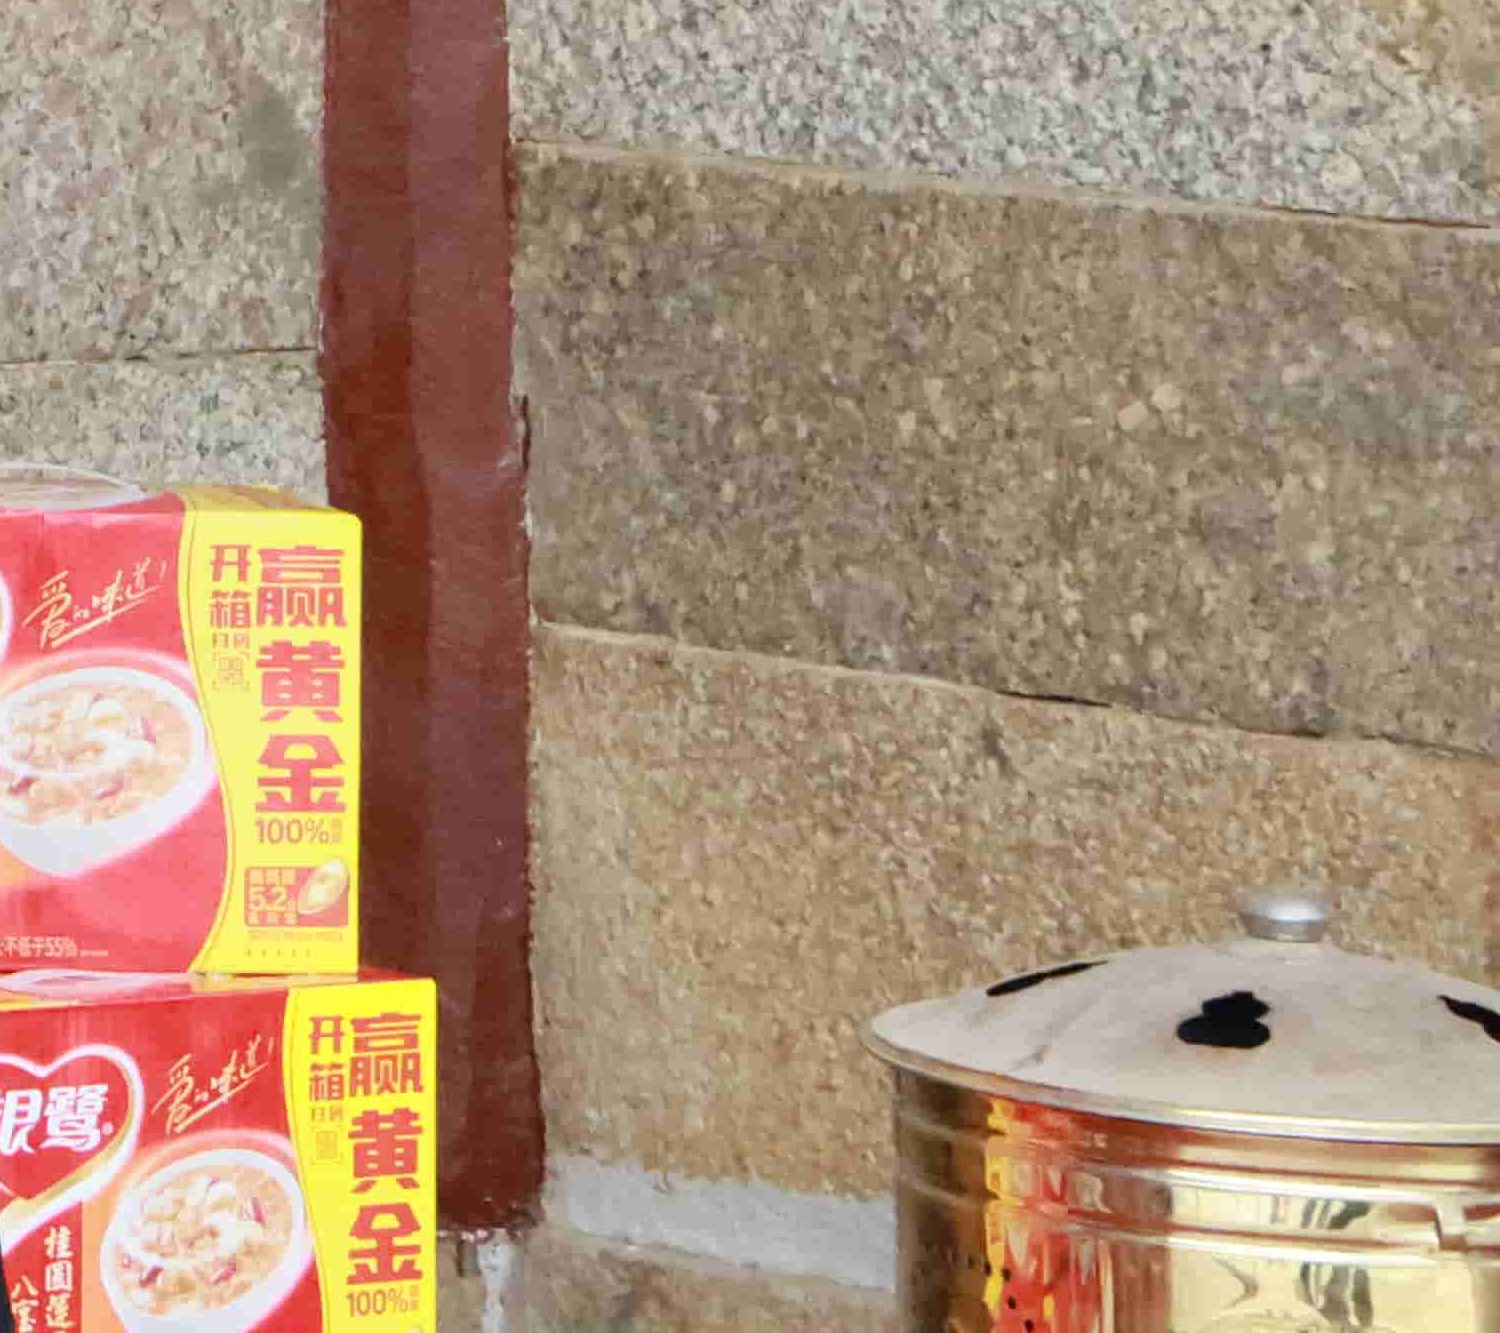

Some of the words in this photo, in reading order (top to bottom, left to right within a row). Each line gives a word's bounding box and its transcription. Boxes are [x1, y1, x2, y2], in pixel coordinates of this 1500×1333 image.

[210, 544, 252, 628] 开箱
[255, 545, 348, 813] 赢黄金
[308, 1015, 345, 1101] 开箱
[348, 1012, 424, 1286] 赢黄金
